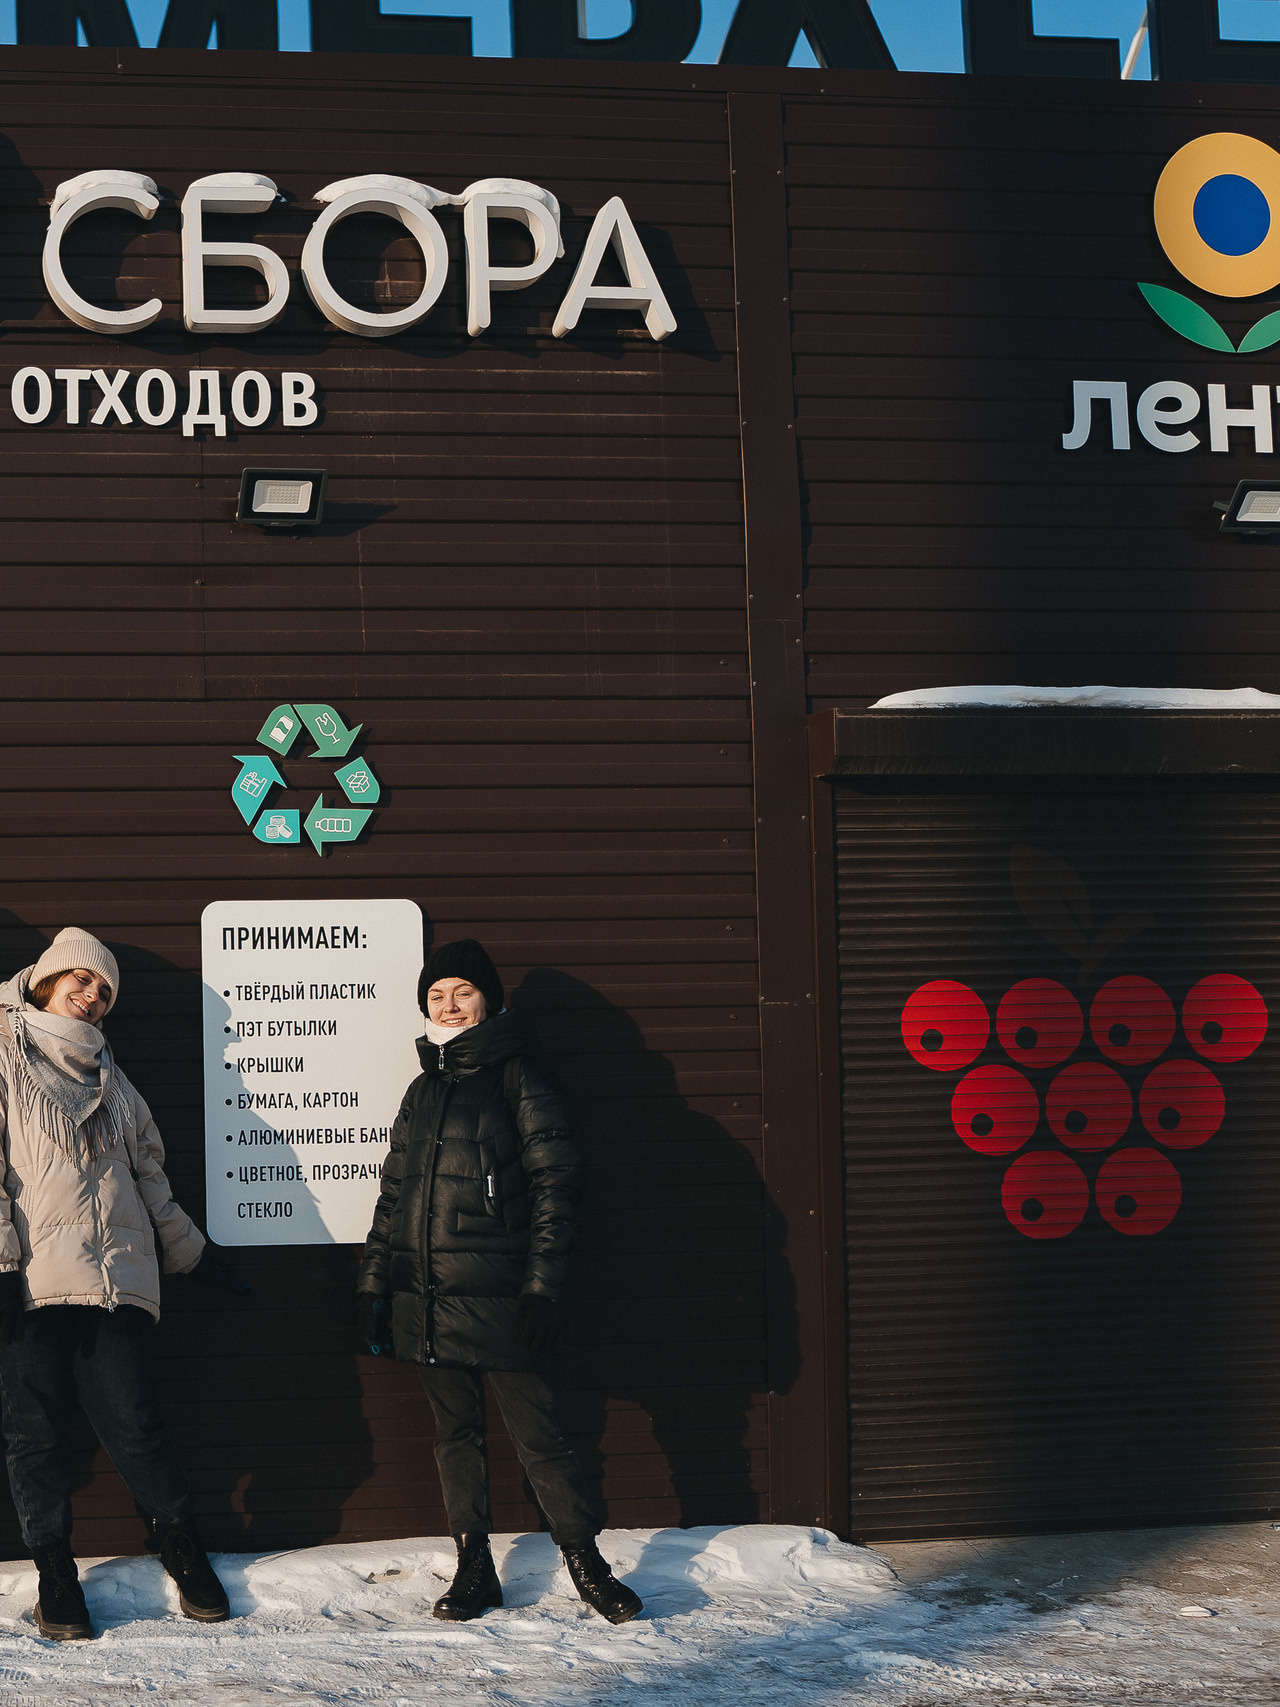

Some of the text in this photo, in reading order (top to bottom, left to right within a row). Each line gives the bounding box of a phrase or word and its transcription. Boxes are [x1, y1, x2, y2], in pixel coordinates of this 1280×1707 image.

[42, 183, 678, 342] СБОРА
[11, 366, 319, 438] ОТХОДОВ
[1062, 380, 1280, 454] лен
[221, 926, 368, 951] ПРИНИМАЕМ:
[235, 981, 376, 1003] ТВЁРДЫЙ ПЛАСТИК
[236, 1020, 337, 1039] ПЭТ БУТЫЛКИ
[237, 1056, 305, 1074] КРЫШКИ
[238, 1091, 359, 1112] БУМАГА, КАРТОН
[237, 1127, 356, 1146] АЛЮМИНИЕВЫЕ
[238, 1165, 309, 1185] ЦВЕТНОЕ,
[237, 1201, 294, 1219] СТЕКЛО
